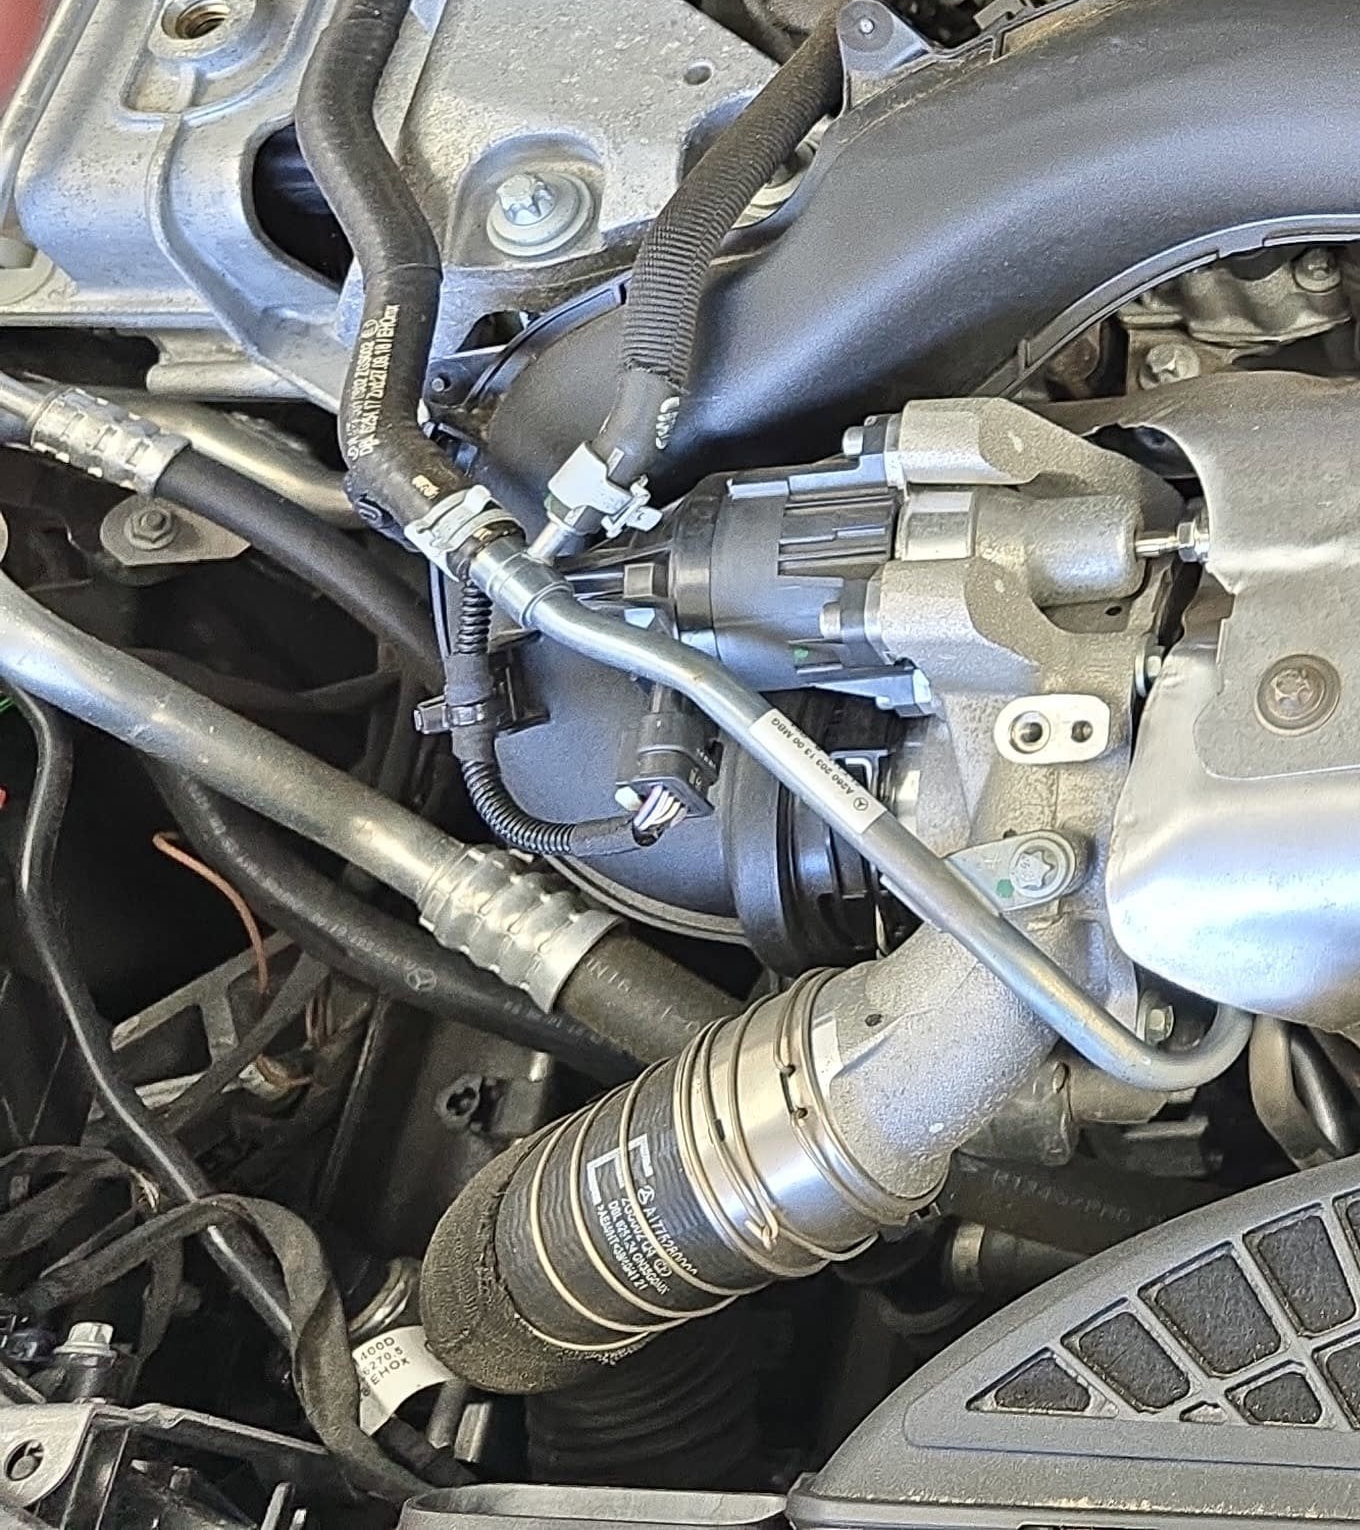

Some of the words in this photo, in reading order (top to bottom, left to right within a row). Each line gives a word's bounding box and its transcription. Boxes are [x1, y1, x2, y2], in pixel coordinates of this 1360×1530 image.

[792, 737, 805, 749] 00
[804, 748, 816, 759] 13
[816, 759, 832, 774] 203
